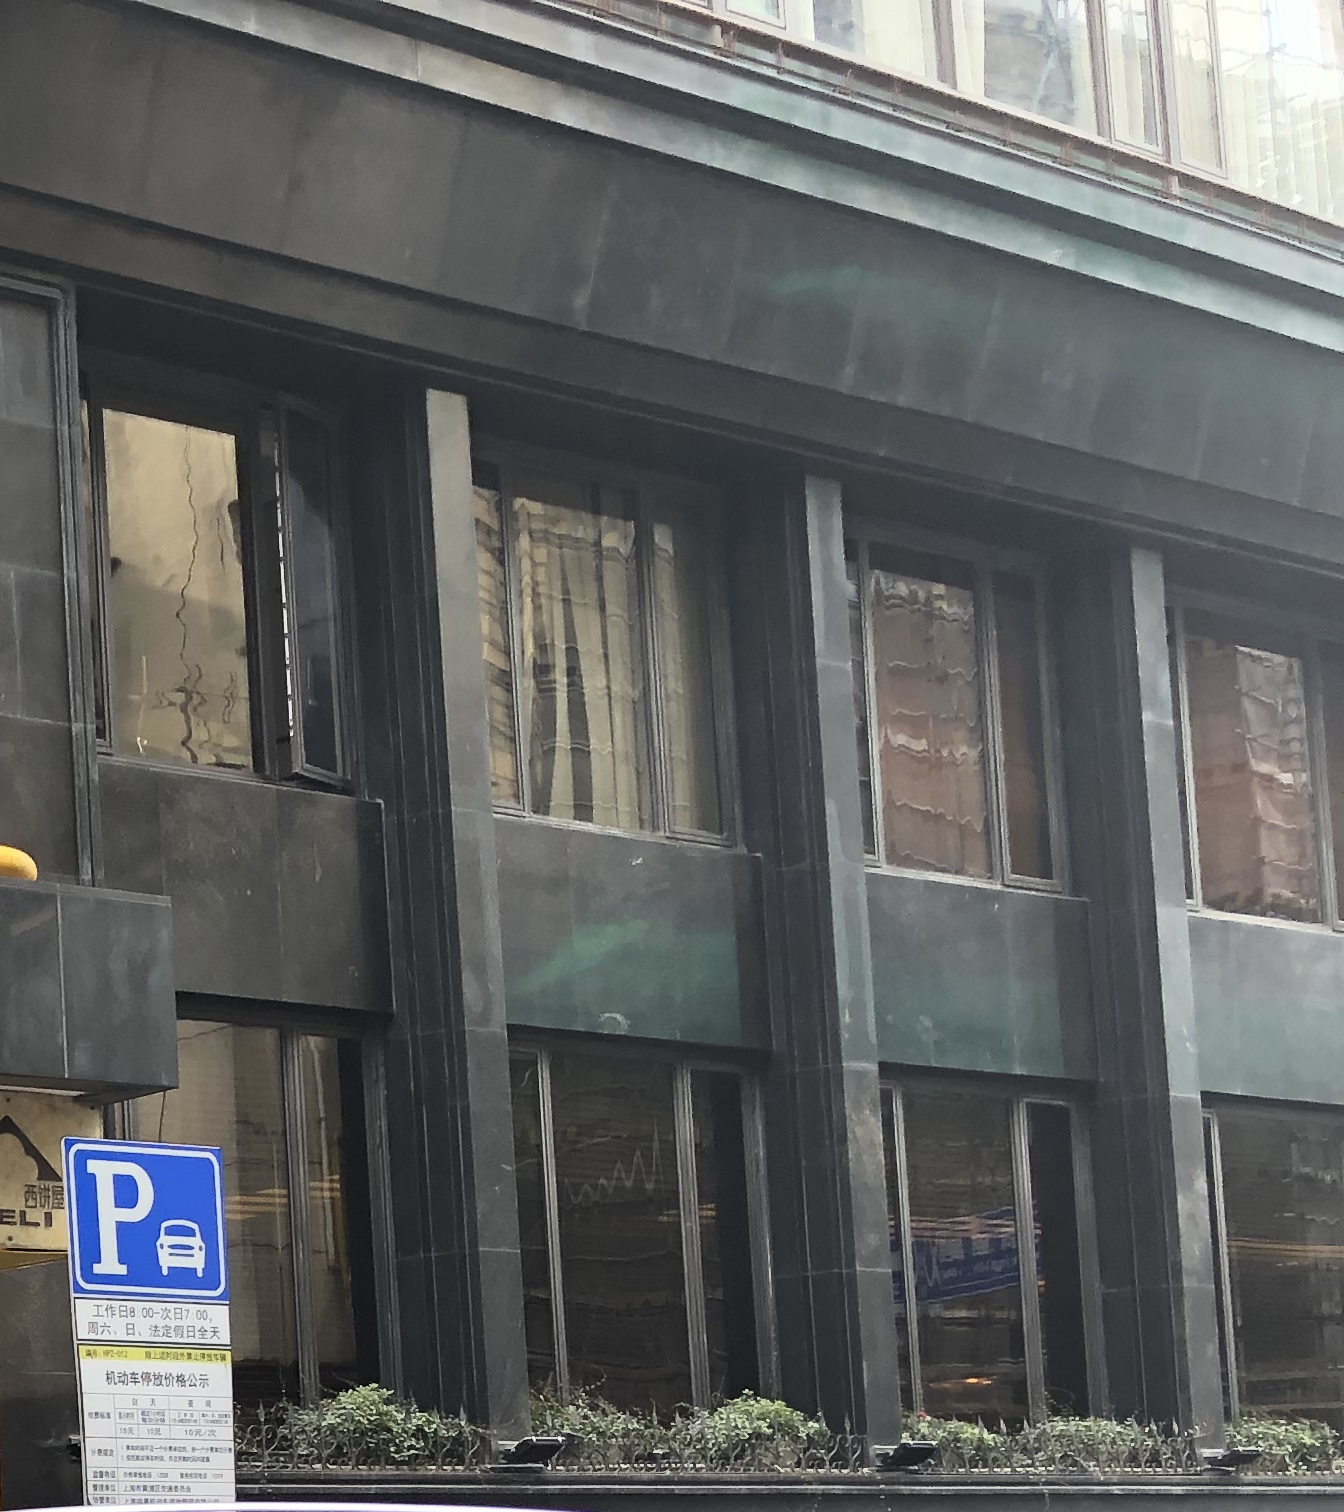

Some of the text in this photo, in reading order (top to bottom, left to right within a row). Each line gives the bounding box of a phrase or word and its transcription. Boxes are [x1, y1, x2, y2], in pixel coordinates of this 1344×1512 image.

[86, 1158, 155, 1276] P
[104, 1370, 210, 1389] 机动车停放价格公示
